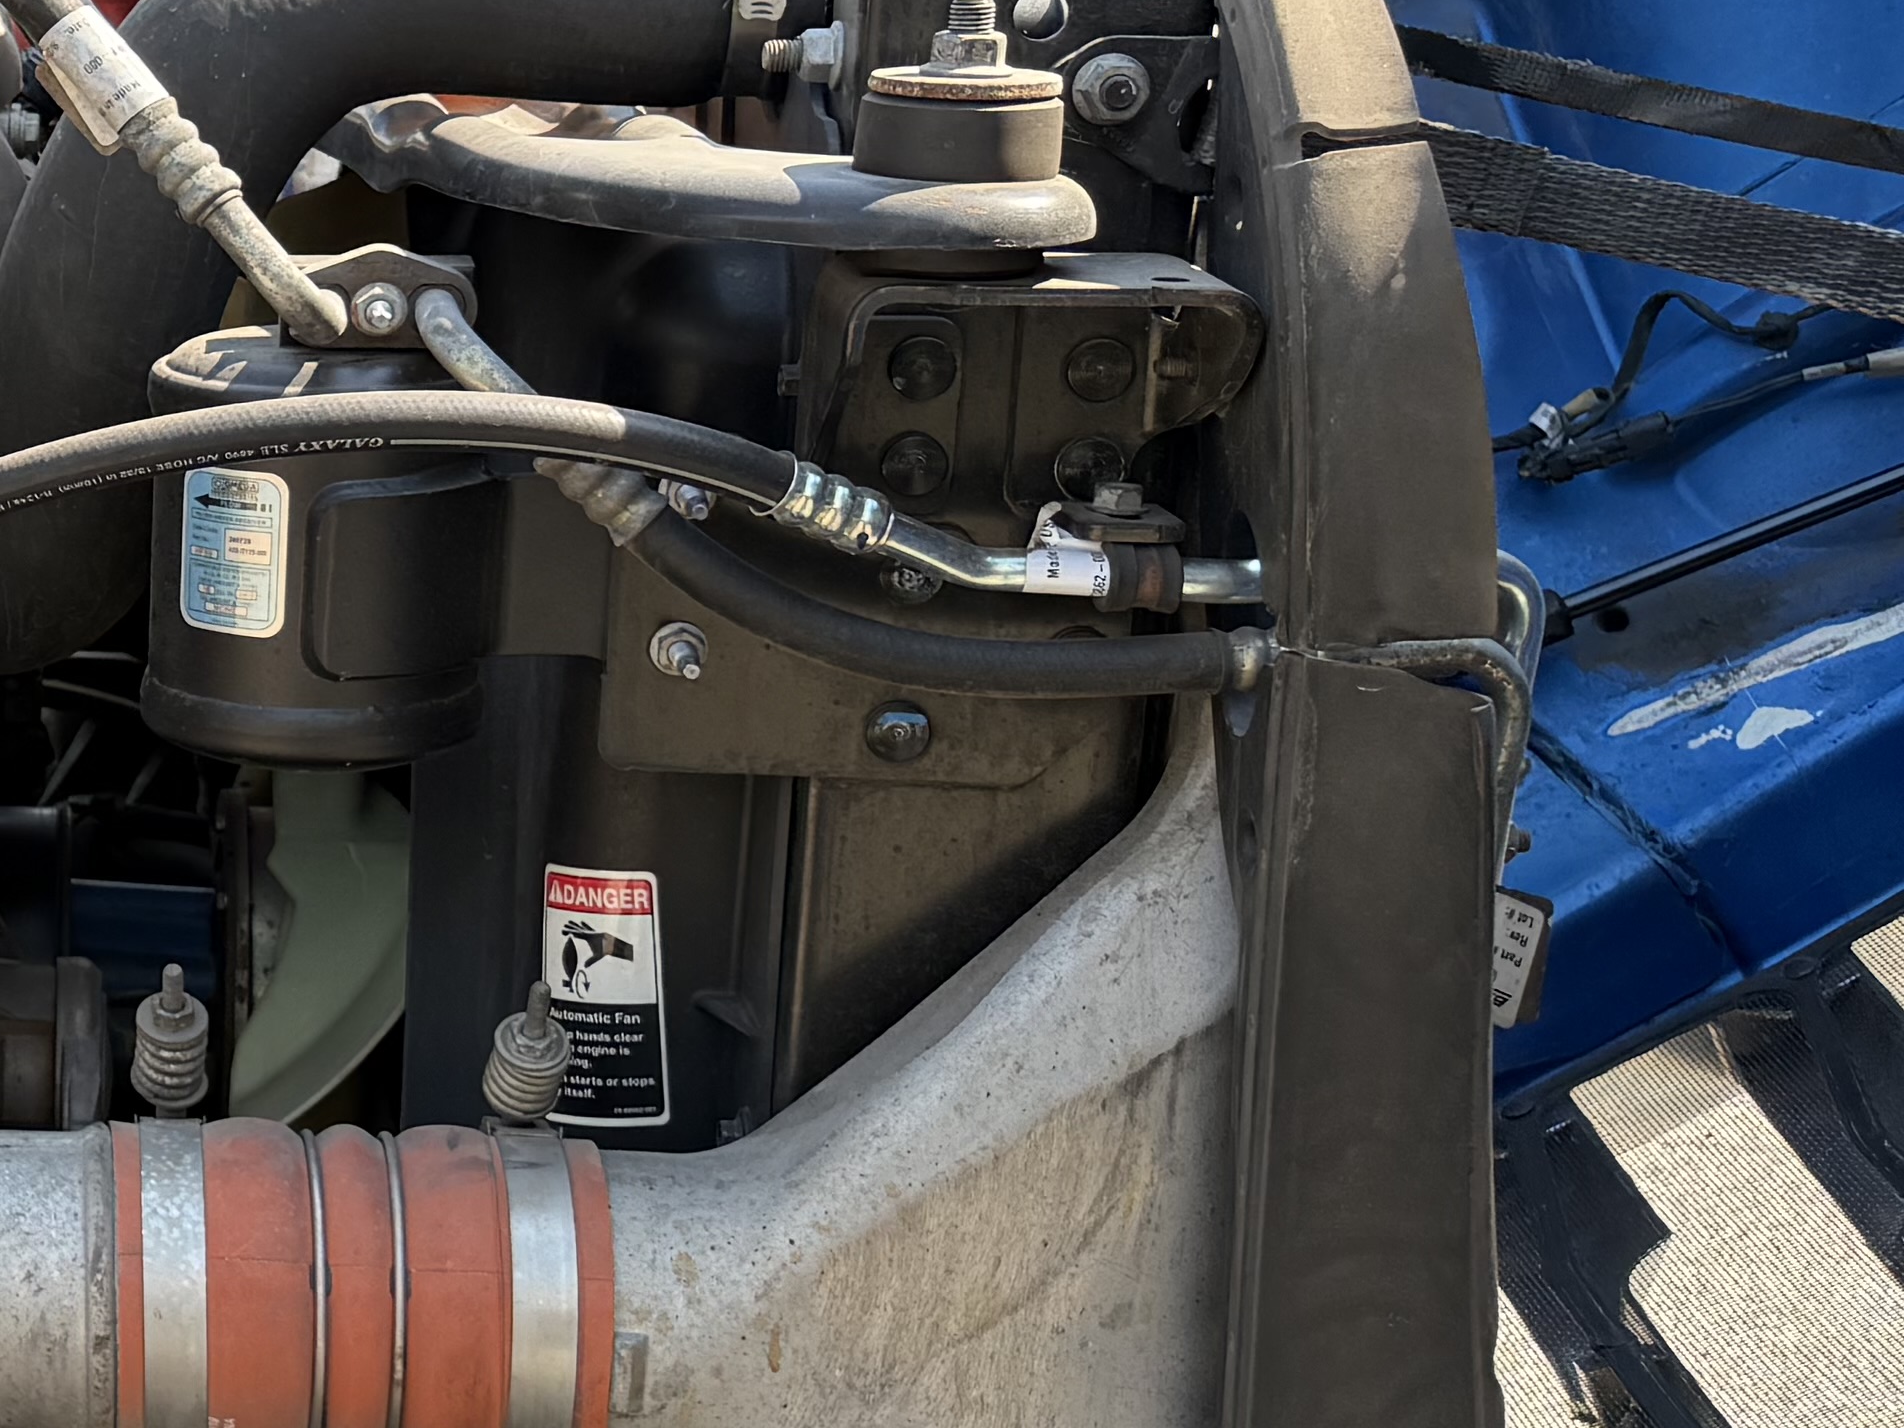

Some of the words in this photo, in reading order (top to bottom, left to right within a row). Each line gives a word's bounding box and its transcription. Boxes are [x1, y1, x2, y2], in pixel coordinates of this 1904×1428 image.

[293, 436, 385, 453] GALAXY
[155, 458, 192, 472] HOSE
[563, 884, 649, 910] DANGER
[549, 1005, 611, 1025] Automatic
[614, 1012, 641, 1026] Fan
[576, 1030, 612, 1042] hands
[614, 1031, 644, 1043] clear
[576, 1046, 617, 1057] engine
[619, 1045, 631, 1056] is
[569, 1057, 593, 1070] ing.
[569, 1074, 604, 1087] starts
[605, 1077, 619, 1087] or
[621, 1077, 657, 1088] stops
